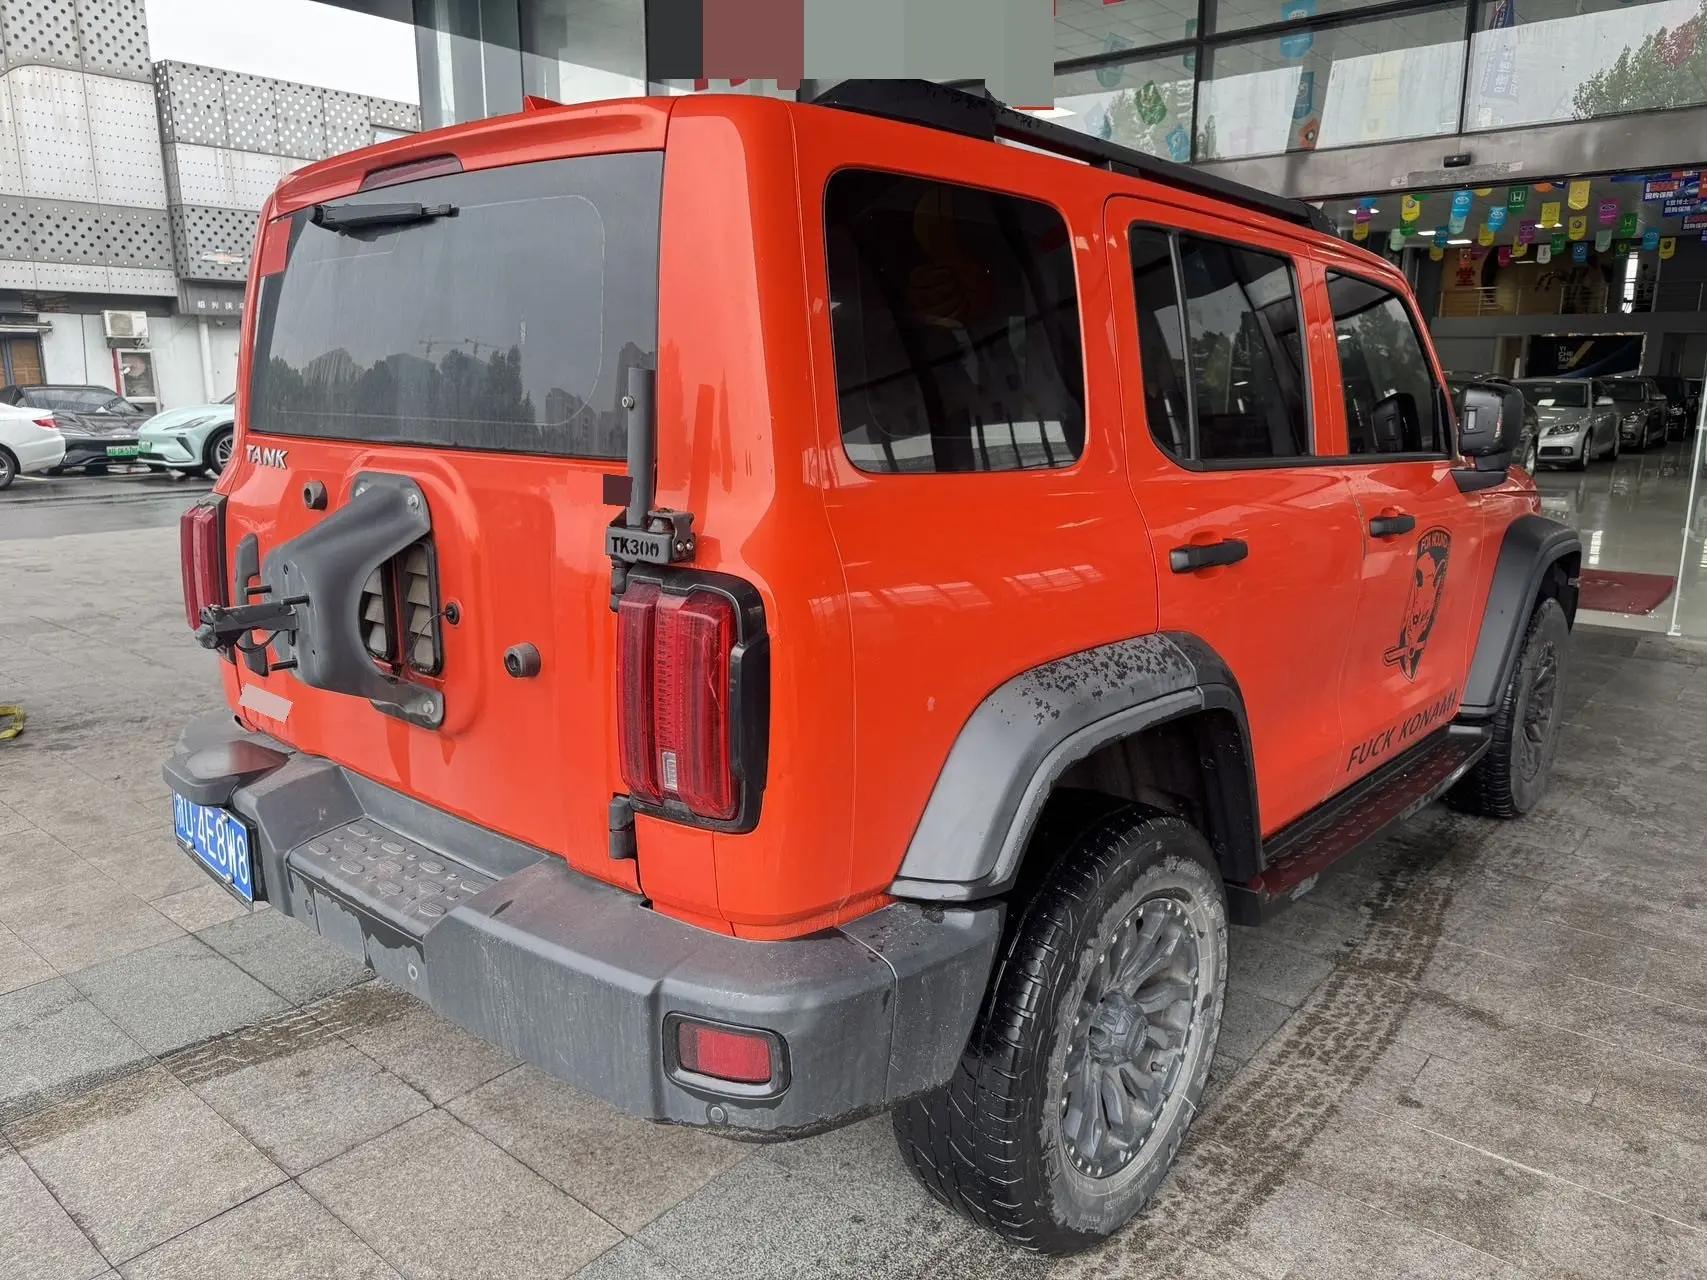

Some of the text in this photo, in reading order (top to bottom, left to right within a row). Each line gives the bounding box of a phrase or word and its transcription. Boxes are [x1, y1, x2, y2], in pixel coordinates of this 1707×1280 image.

[246, 444, 289, 470] TANK
[1346, 687, 1458, 772] FUCK KONAMI
